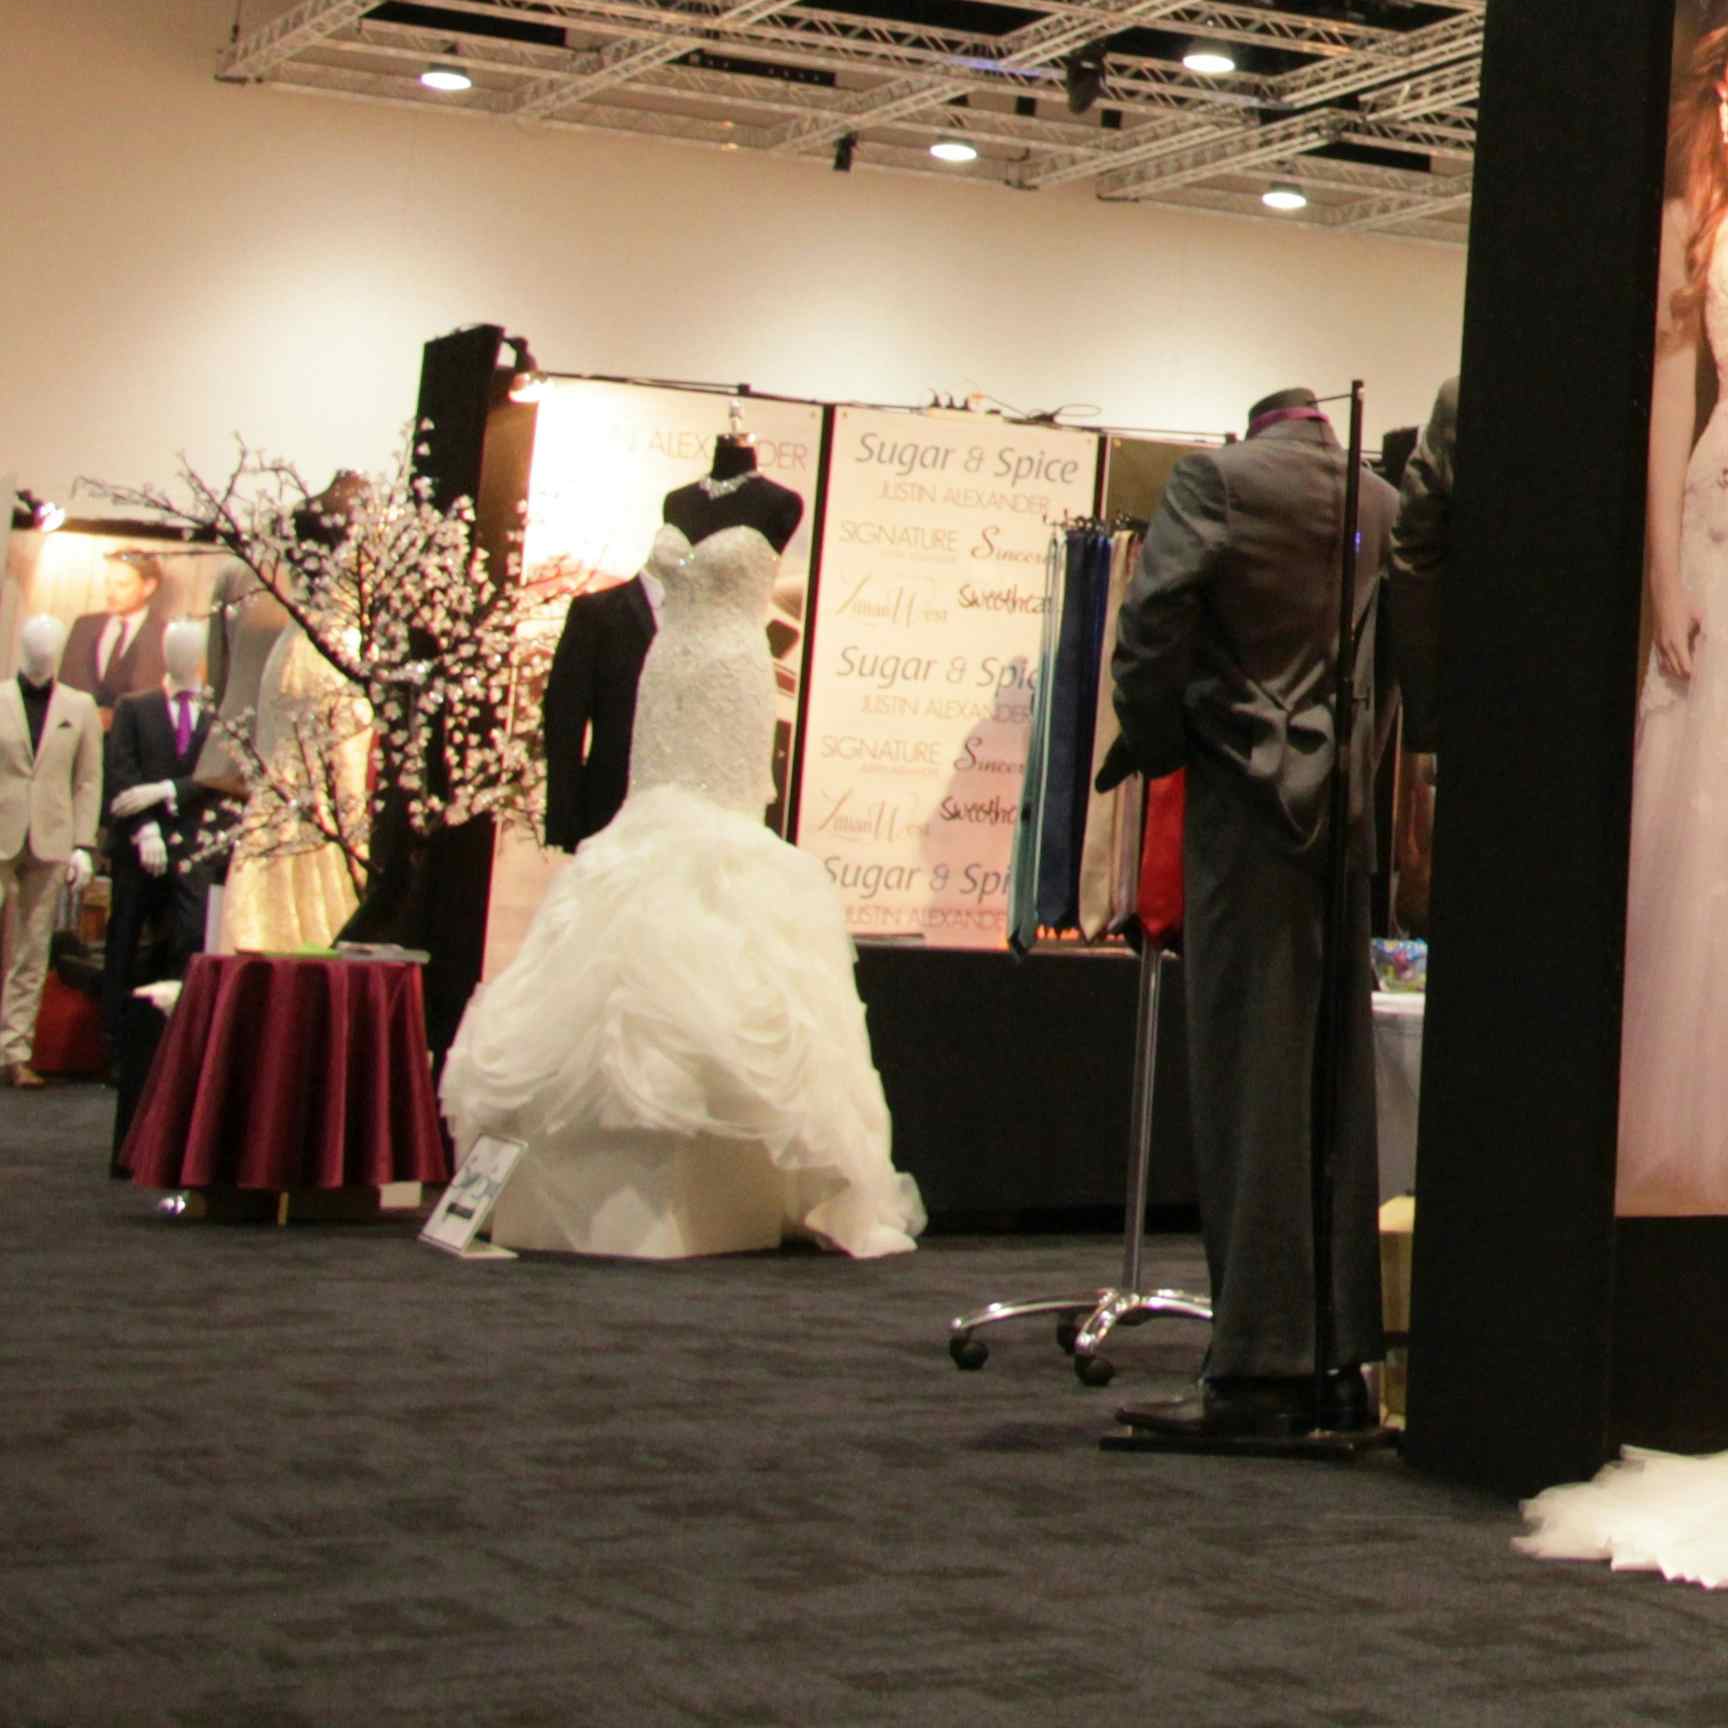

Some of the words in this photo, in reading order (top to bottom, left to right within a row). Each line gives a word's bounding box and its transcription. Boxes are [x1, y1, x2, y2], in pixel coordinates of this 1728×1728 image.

[854, 431, 956, 477] Sugar
[963, 443, 985, 474] &
[993, 445, 1079, 488] Spice
[839, 519, 961, 553] SIGNATURE
[836, 644, 940, 690] Sugar
[944, 655, 968, 684] &
[975, 655, 1039, 699] Spic
[819, 733, 944, 765] SIGNATURE
[822, 855, 921, 900] Sugar
[929, 862, 952, 892] &
[959, 861, 1012, 904] Spi
